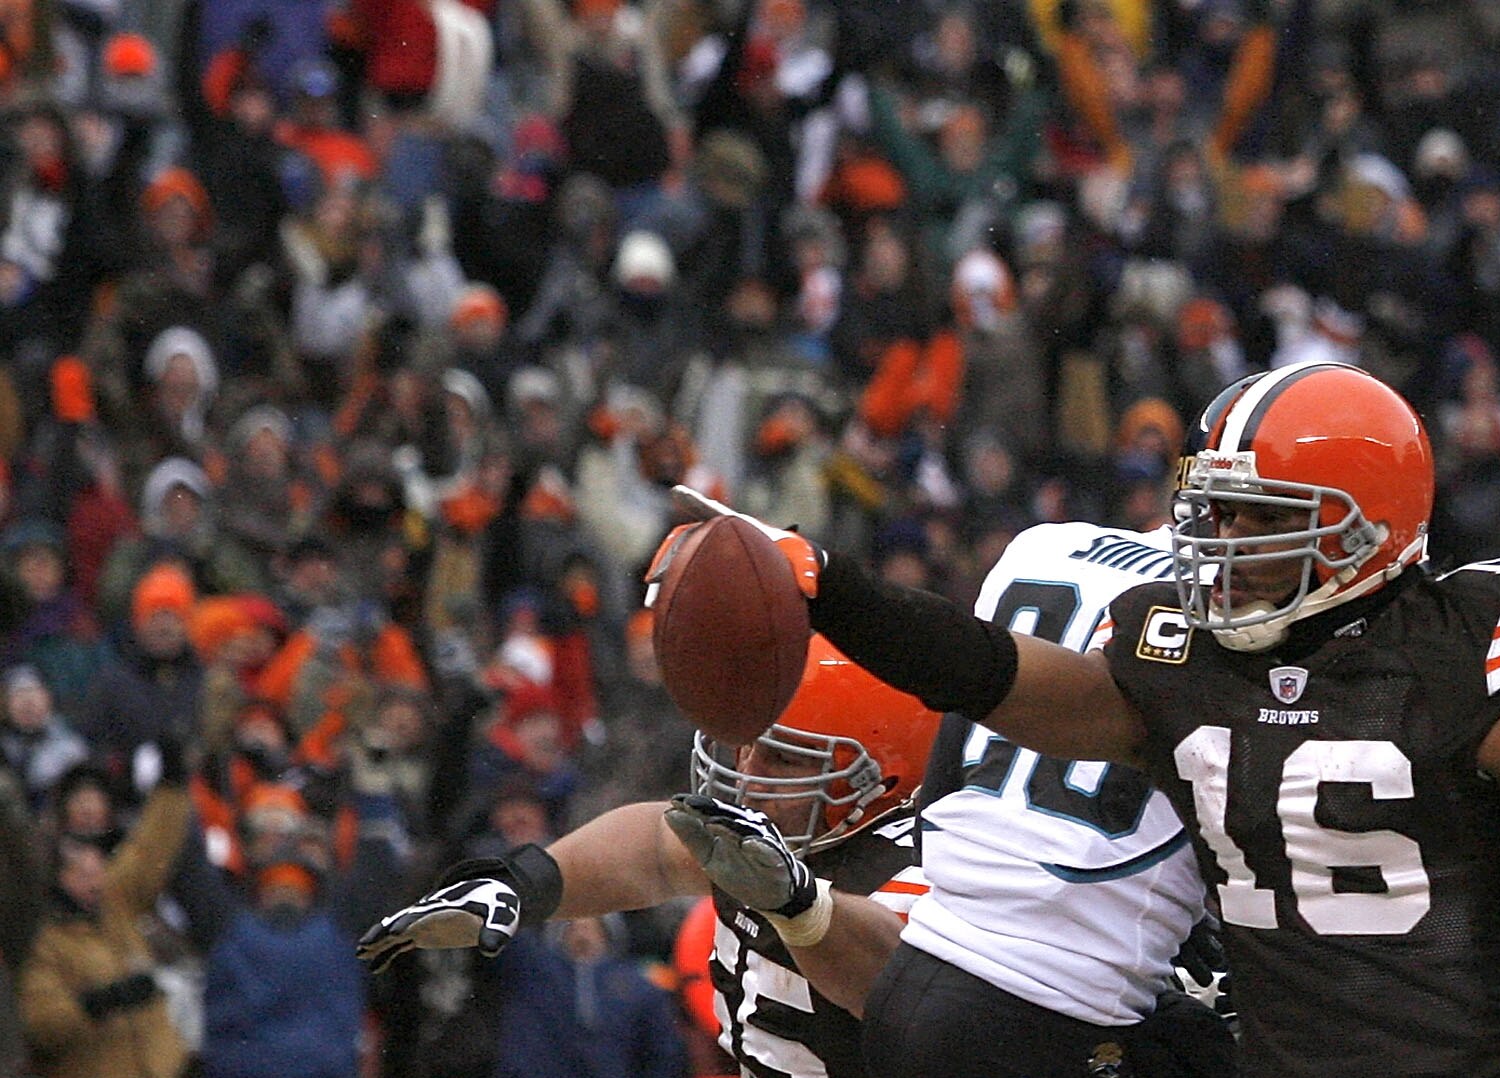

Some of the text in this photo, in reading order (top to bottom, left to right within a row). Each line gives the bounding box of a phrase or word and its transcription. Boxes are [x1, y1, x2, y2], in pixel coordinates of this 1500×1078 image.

[1146, 612, 1188, 648] C
[1257, 708, 1319, 725] BROWNS
[1174, 725, 1431, 935] 16
